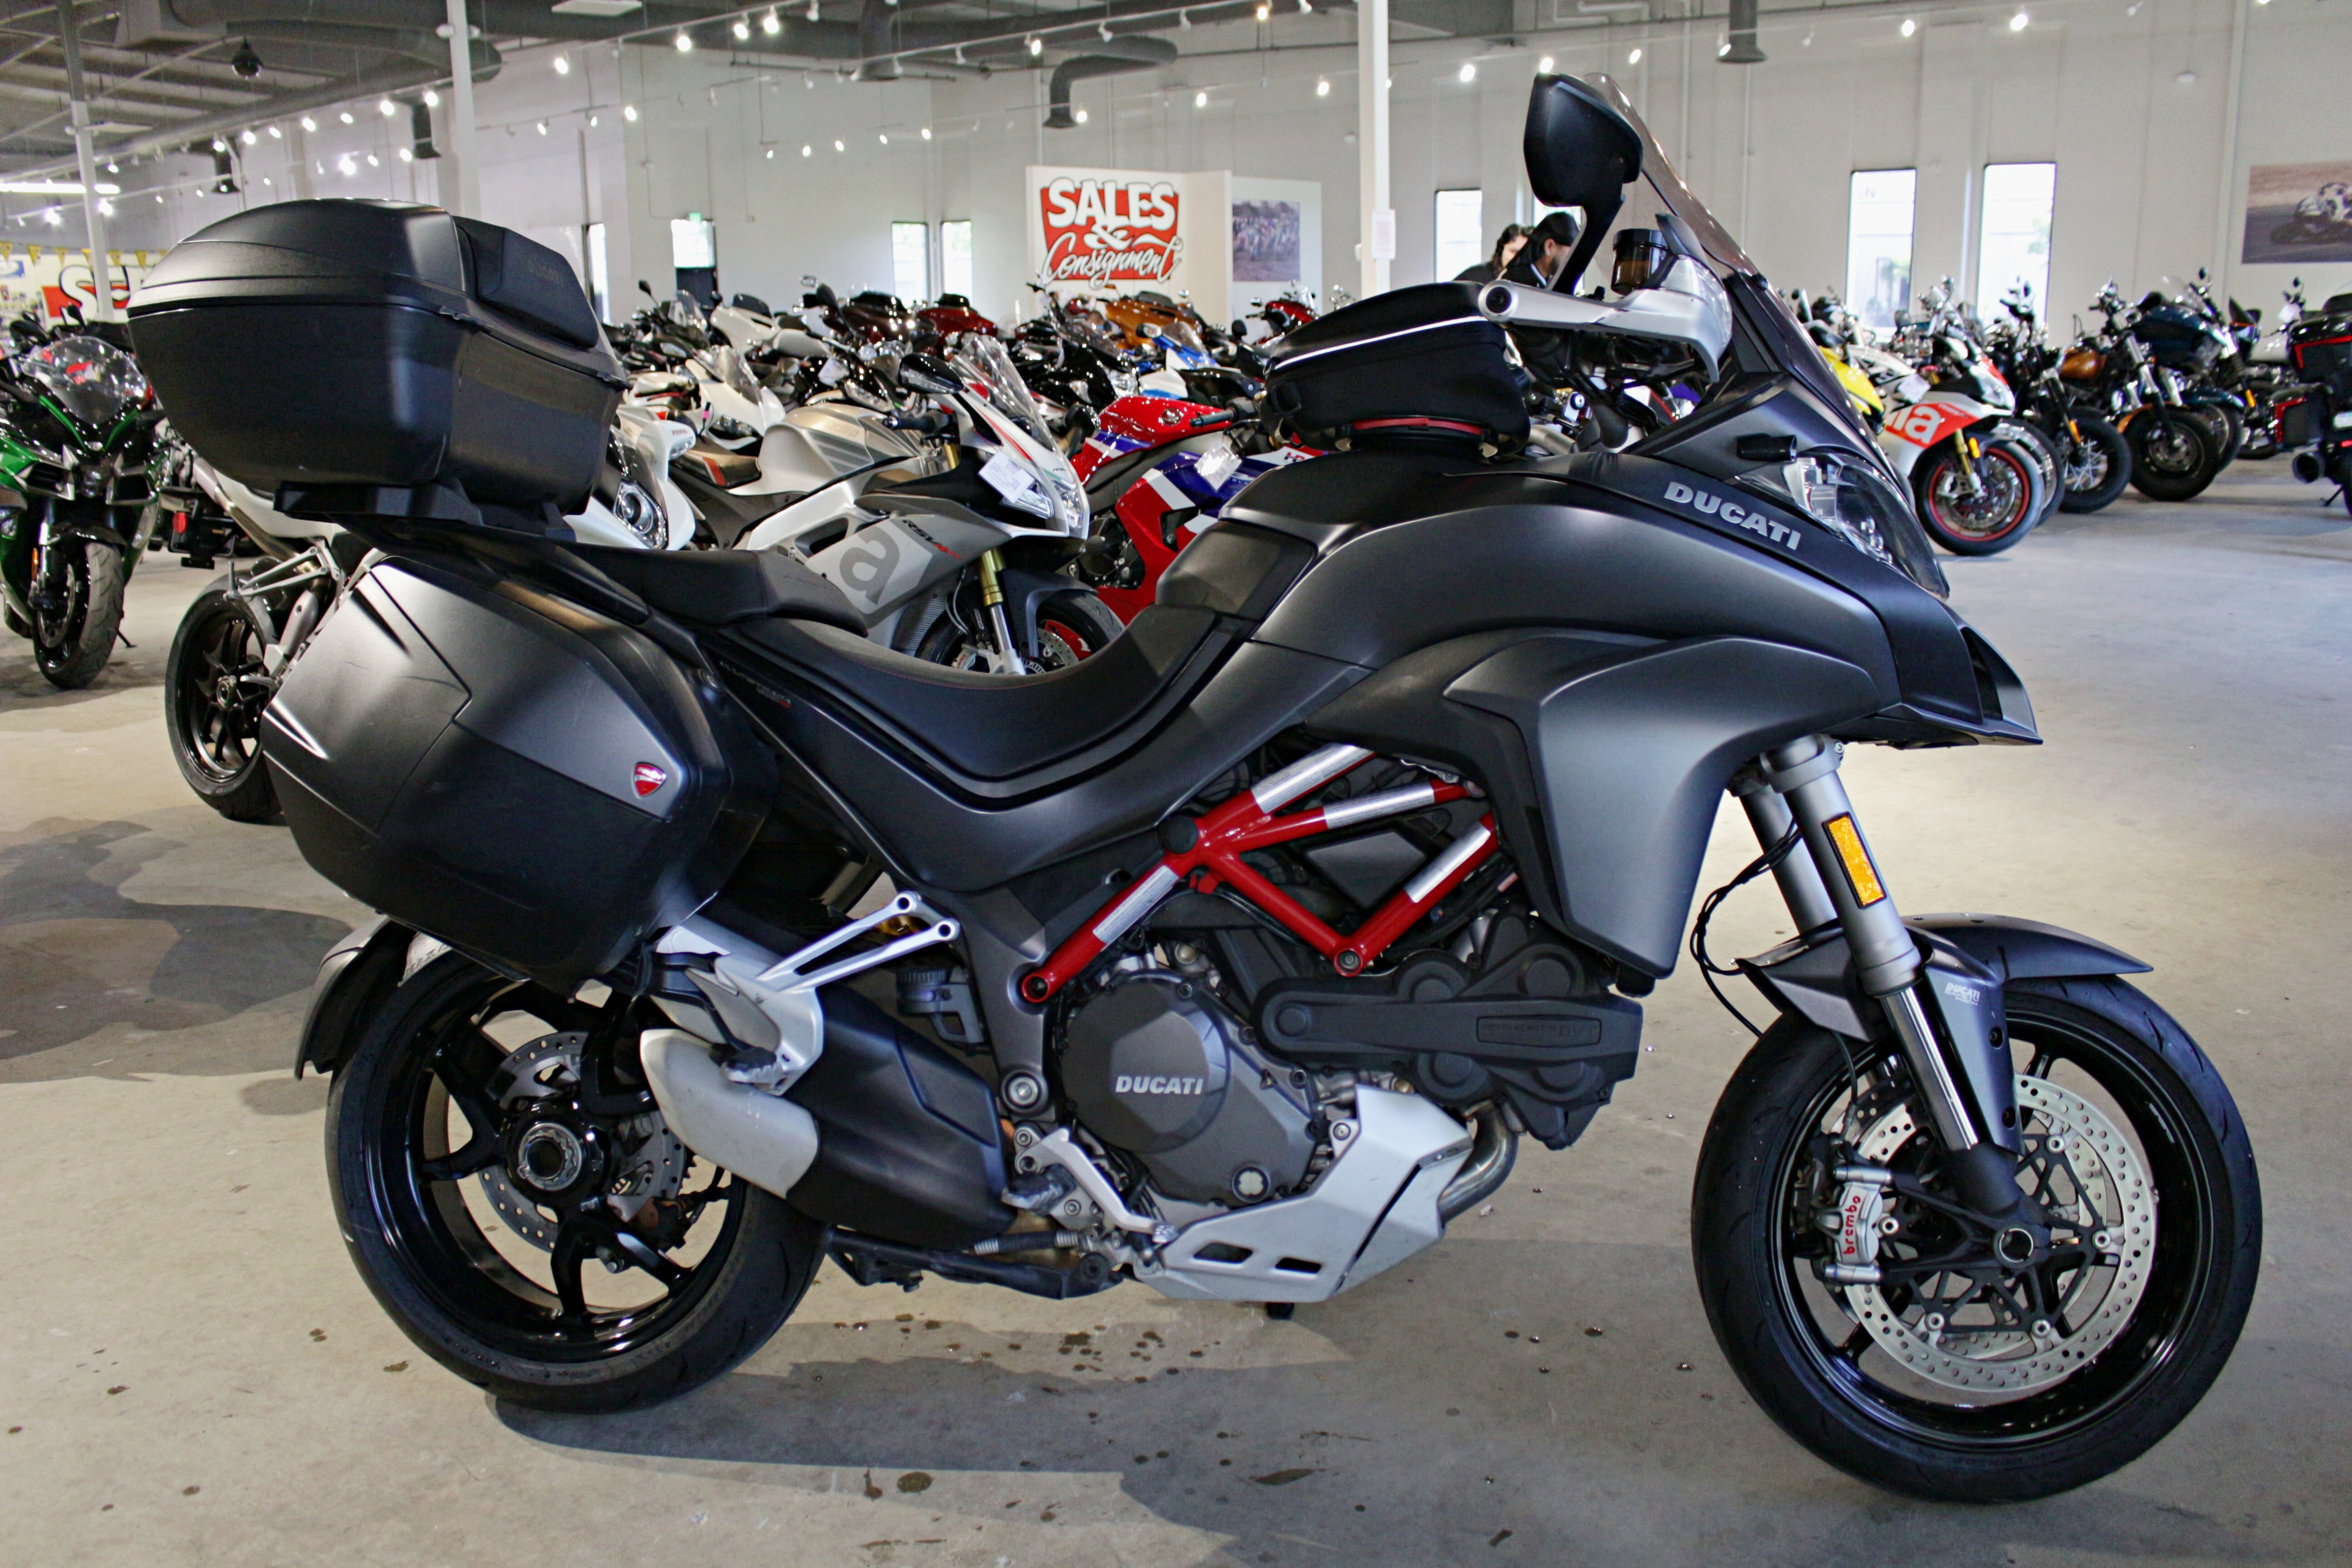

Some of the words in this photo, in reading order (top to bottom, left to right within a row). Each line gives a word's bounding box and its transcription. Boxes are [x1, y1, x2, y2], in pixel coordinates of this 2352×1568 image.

[1048, 176, 1176, 230] SALES
[1044, 231, 1183, 289] Consignment
[1083, 223, 1136, 250] &
[1664, 481, 1801, 550] DUCATI
[1945, 982, 1980, 1000] DUCATI
[1116, 1076, 1203, 1095] DUCATI
[1843, 1196, 1861, 1254] brembo
